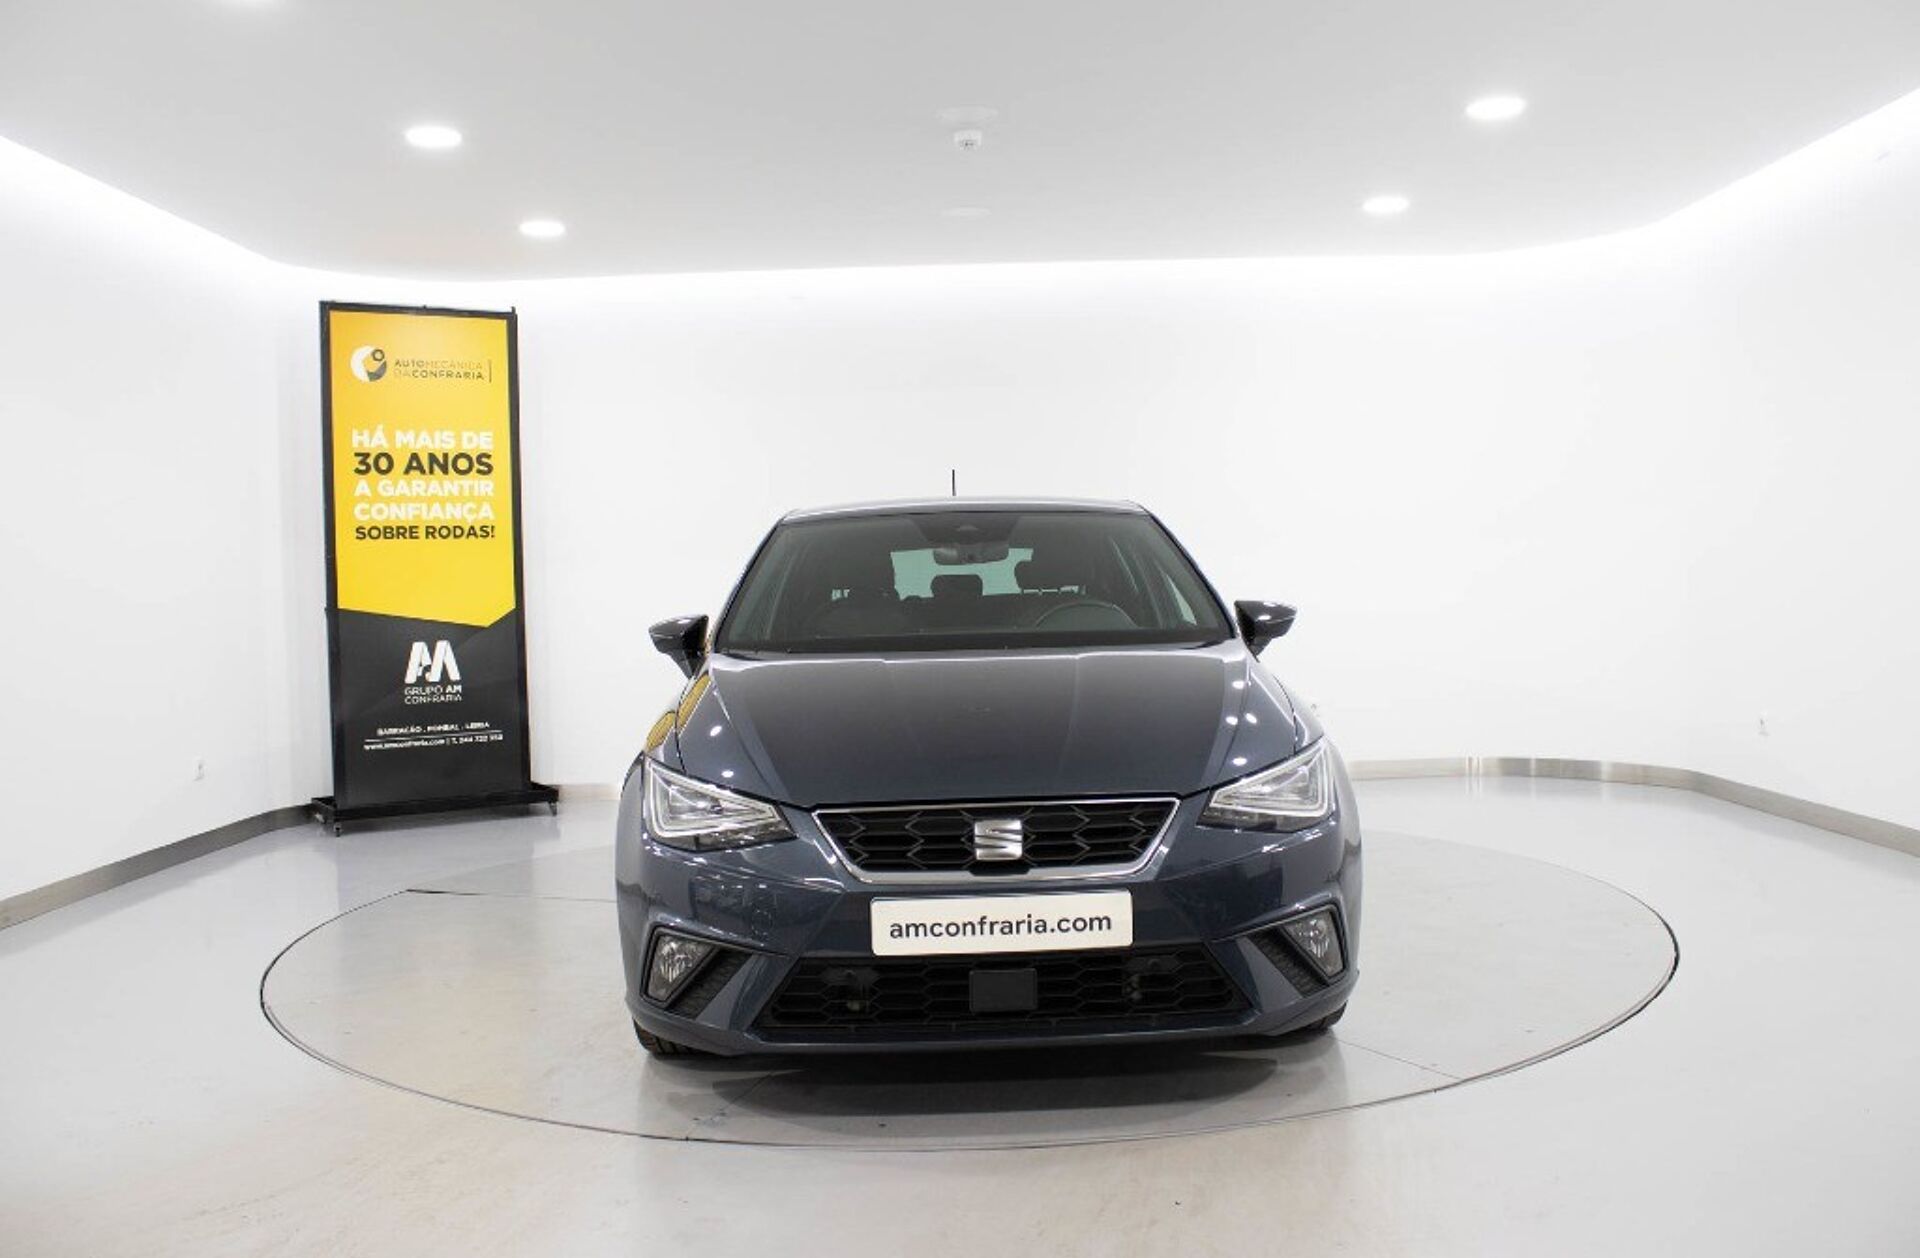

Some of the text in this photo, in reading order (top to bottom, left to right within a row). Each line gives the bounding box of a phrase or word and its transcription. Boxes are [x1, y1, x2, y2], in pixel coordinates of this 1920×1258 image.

[351, 424, 494, 450] HÁ MAIS DE
[353, 452, 494, 476] 30 ANOS
[353, 479, 494, 497] A GARANTIR
[353, 502, 495, 523] CONFIANÇA
[355, 525, 496, 540] SOBRE RODAS!
[404, 684, 462, 696] GRUPO AM
[404, 693, 462, 705] CONFRARIA
[889, 913, 1112, 939] amconfraria.com
